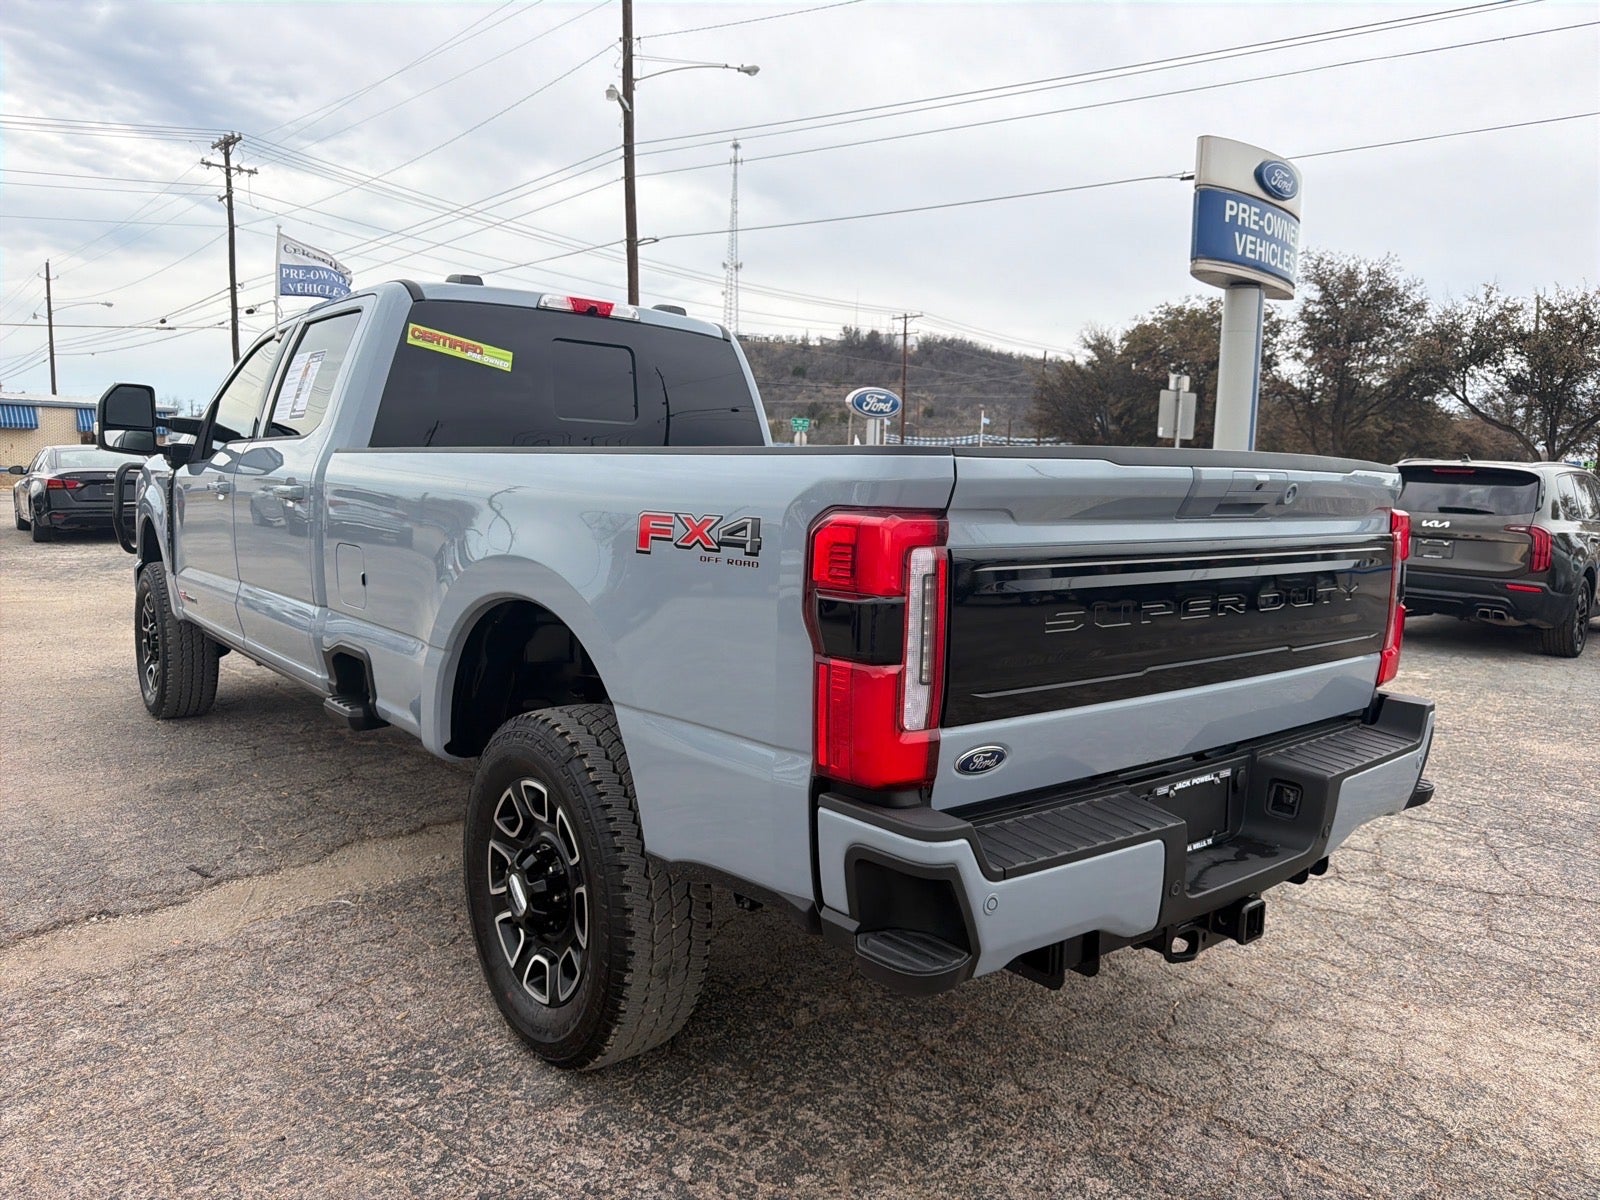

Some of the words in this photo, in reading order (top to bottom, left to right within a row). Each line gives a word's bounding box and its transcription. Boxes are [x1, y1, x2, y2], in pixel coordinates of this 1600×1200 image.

[1270, 168, 1294, 193] Ford
[1225, 199, 1298, 249] PRE-OWNE
[1234, 231, 1295, 275] VEHICLES
[288, 282, 347, 297] VEHICLES
[410, 326, 484, 356] CERTIFIED
[467, 350, 509, 369] PRE-OWNED
[862, 393, 893, 413] Ford
[636, 509, 762, 557] FX4
[1421, 519, 1451, 529] KIA
[699, 555, 722, 564] OFF
[726, 558, 760, 569] ROAD
[1044, 594, 1246, 634] SUPER
[1259, 583, 1360, 612] DUTY
[968, 752, 999, 771] Ford
[1173, 779, 1191, 790] JACK
[1191, 773, 1215, 786] POWELL
